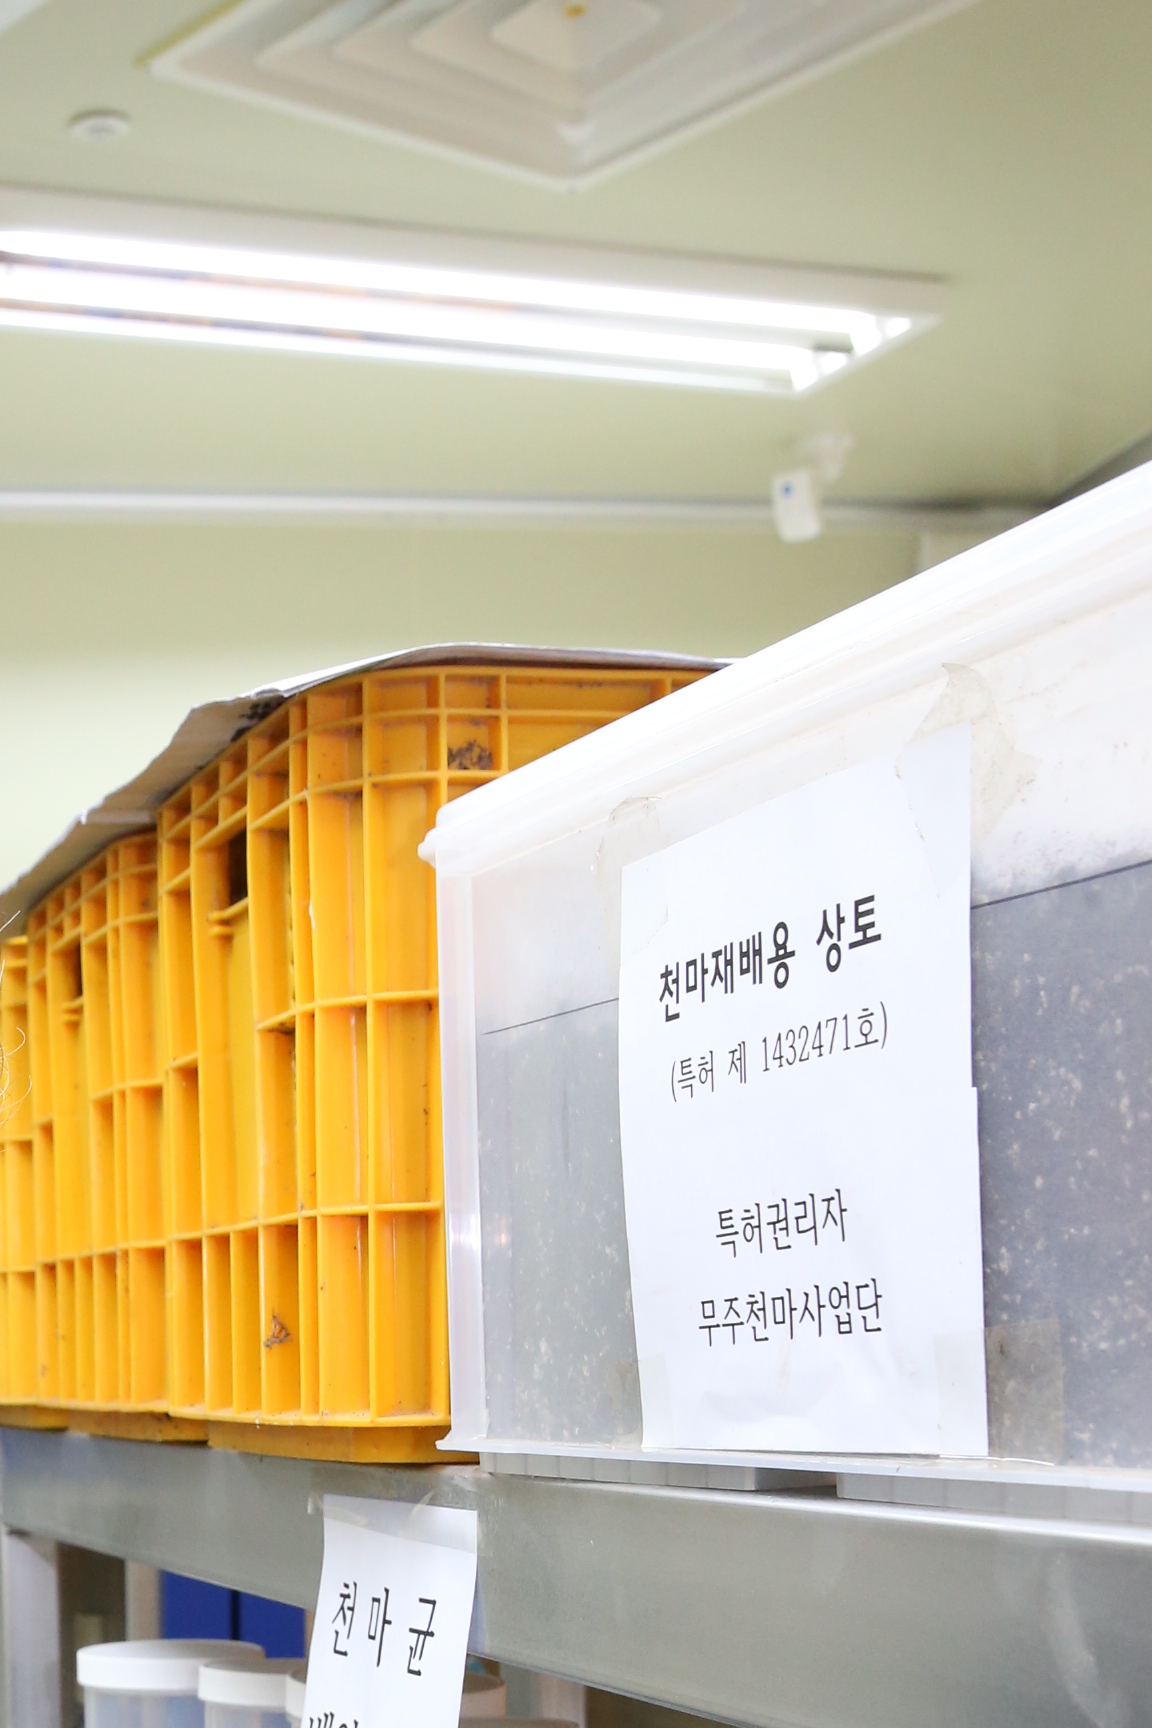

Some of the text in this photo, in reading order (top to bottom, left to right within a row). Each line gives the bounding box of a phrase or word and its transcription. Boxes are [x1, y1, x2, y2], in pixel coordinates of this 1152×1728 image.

[659, 895, 882, 1023] 천마재배용 상토
[671, 1001, 887, 1103] (특허 제 1432471호)
[715, 1188, 848, 1258] 특허권리자
[698, 1277, 883, 1348] 무주천마사업단
